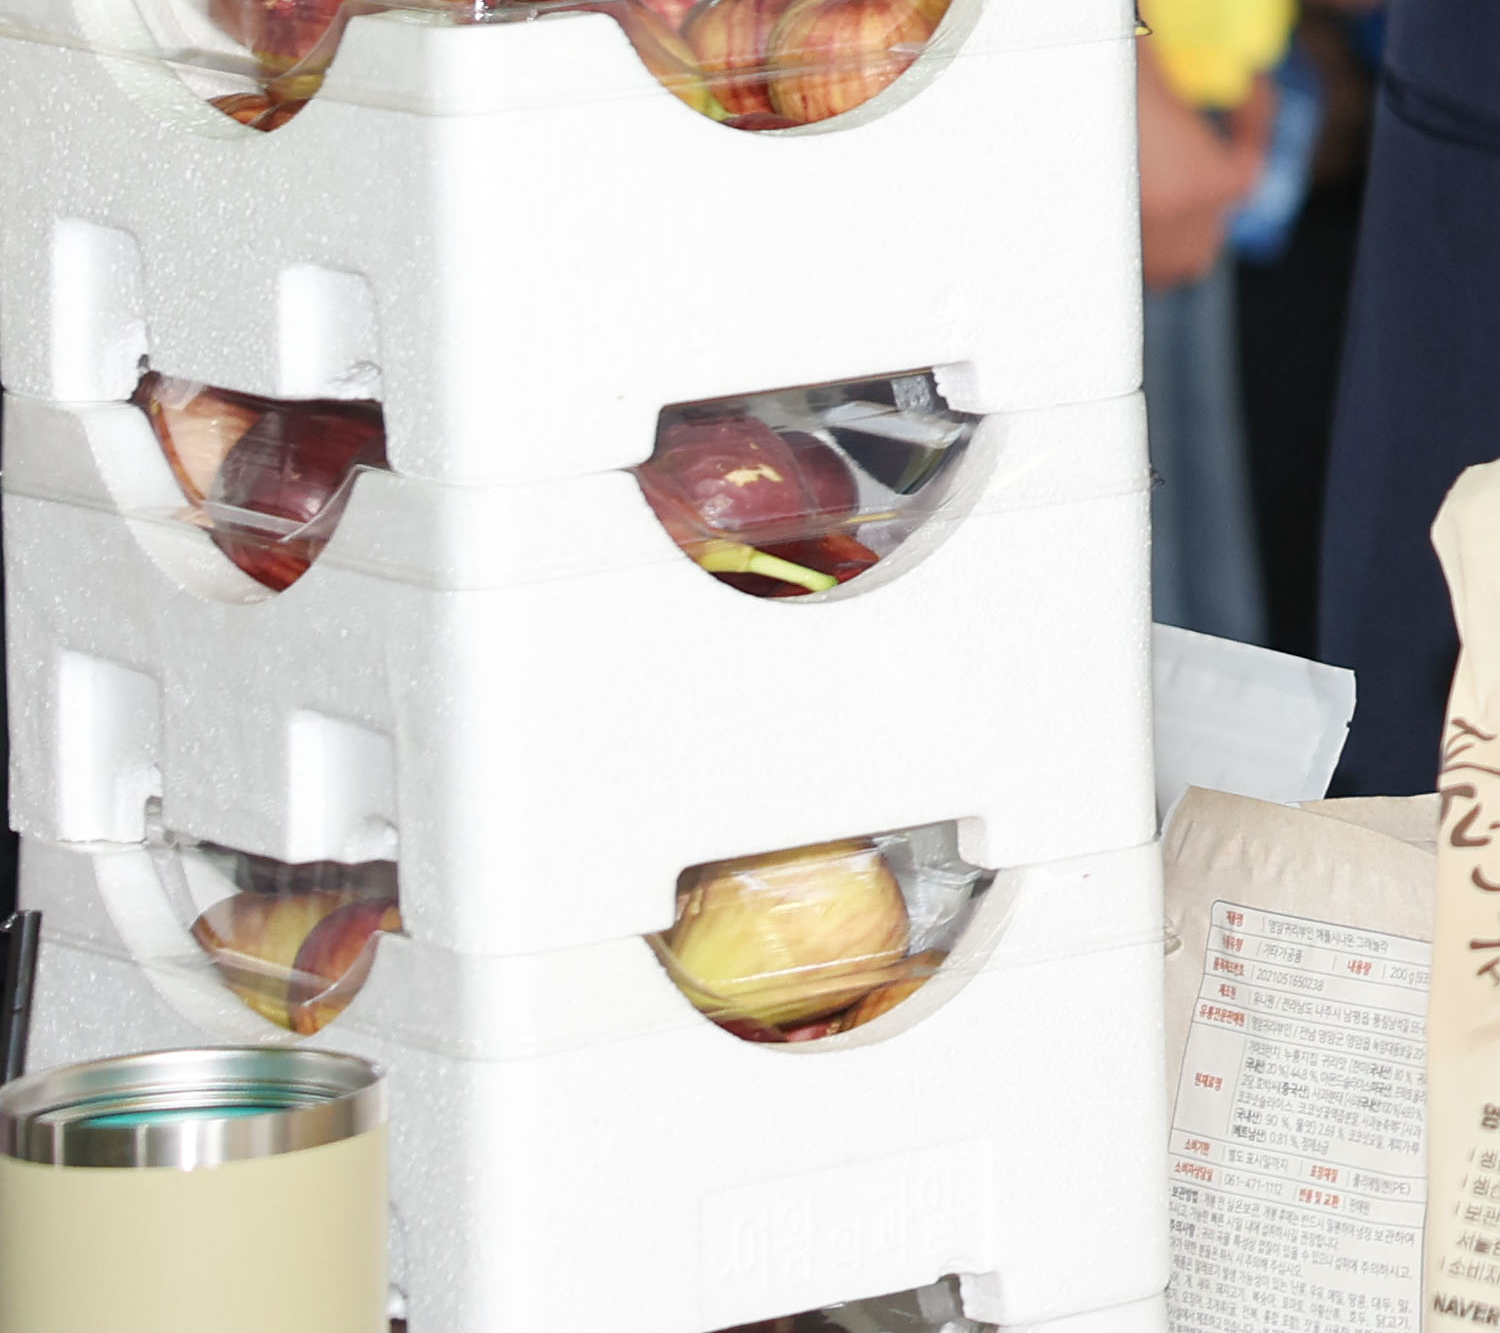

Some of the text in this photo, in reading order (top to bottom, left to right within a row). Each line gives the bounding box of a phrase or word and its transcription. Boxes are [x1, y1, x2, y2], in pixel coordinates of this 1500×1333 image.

[1262, 943, 1303, 964] 기타가공품
[1317, 1029, 1345, 1047] 영암군
[1222, 1172, 1282, 1195] 061-471-1112
[1433, 1293, 1500, 1326] NAVER
